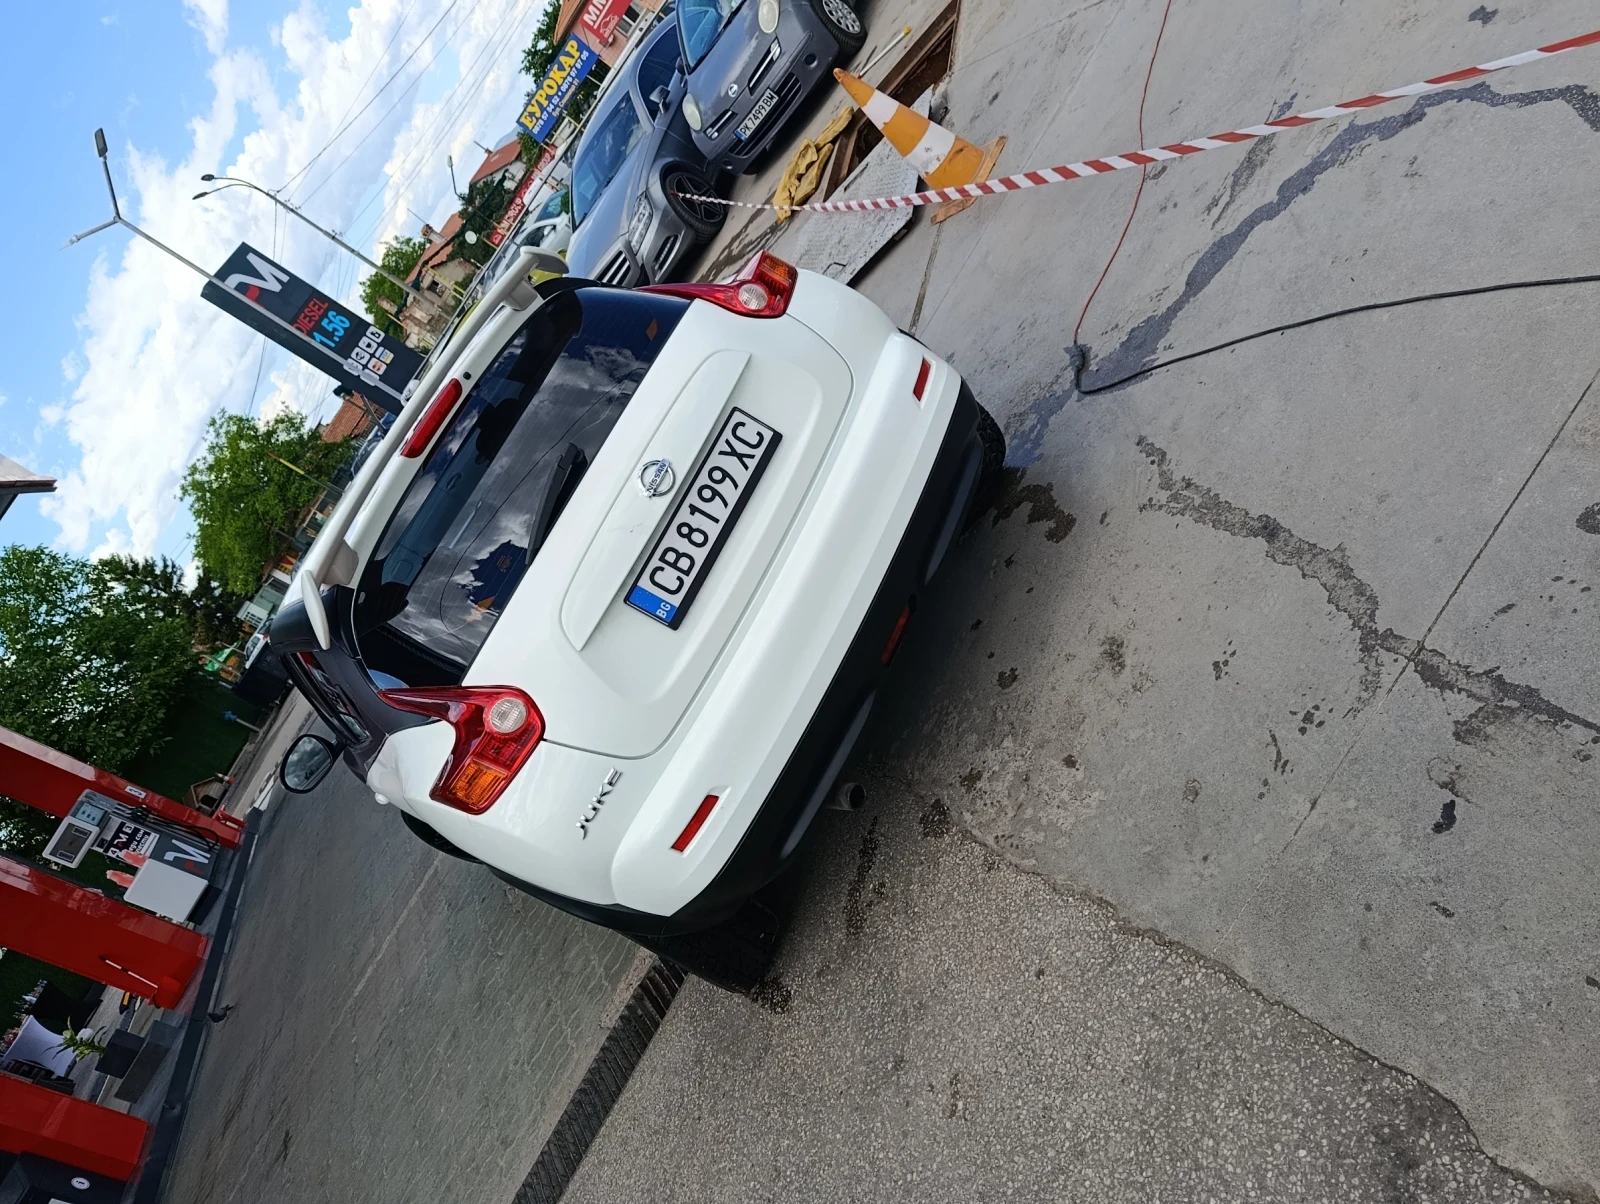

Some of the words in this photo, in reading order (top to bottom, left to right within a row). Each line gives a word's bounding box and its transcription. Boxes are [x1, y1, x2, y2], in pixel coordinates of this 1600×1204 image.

[520, 40, 580, 129] ЕУРОКАР
[740, 123, 752, 136] PK
[747, 103, 767, 125] 7499
[762, 92, 776, 107] BM
[292, 298, 329, 336] DIESEL
[313, 310, 350, 348] 1.56
[647, 462, 667, 493] NISSAN
[649, 545, 697, 595] CB
[676, 464, 739, 548] 8199
[718, 422, 764, 469] XC
[655, 601, 671, 618] BG
[575, 767, 621, 839] JUKE
